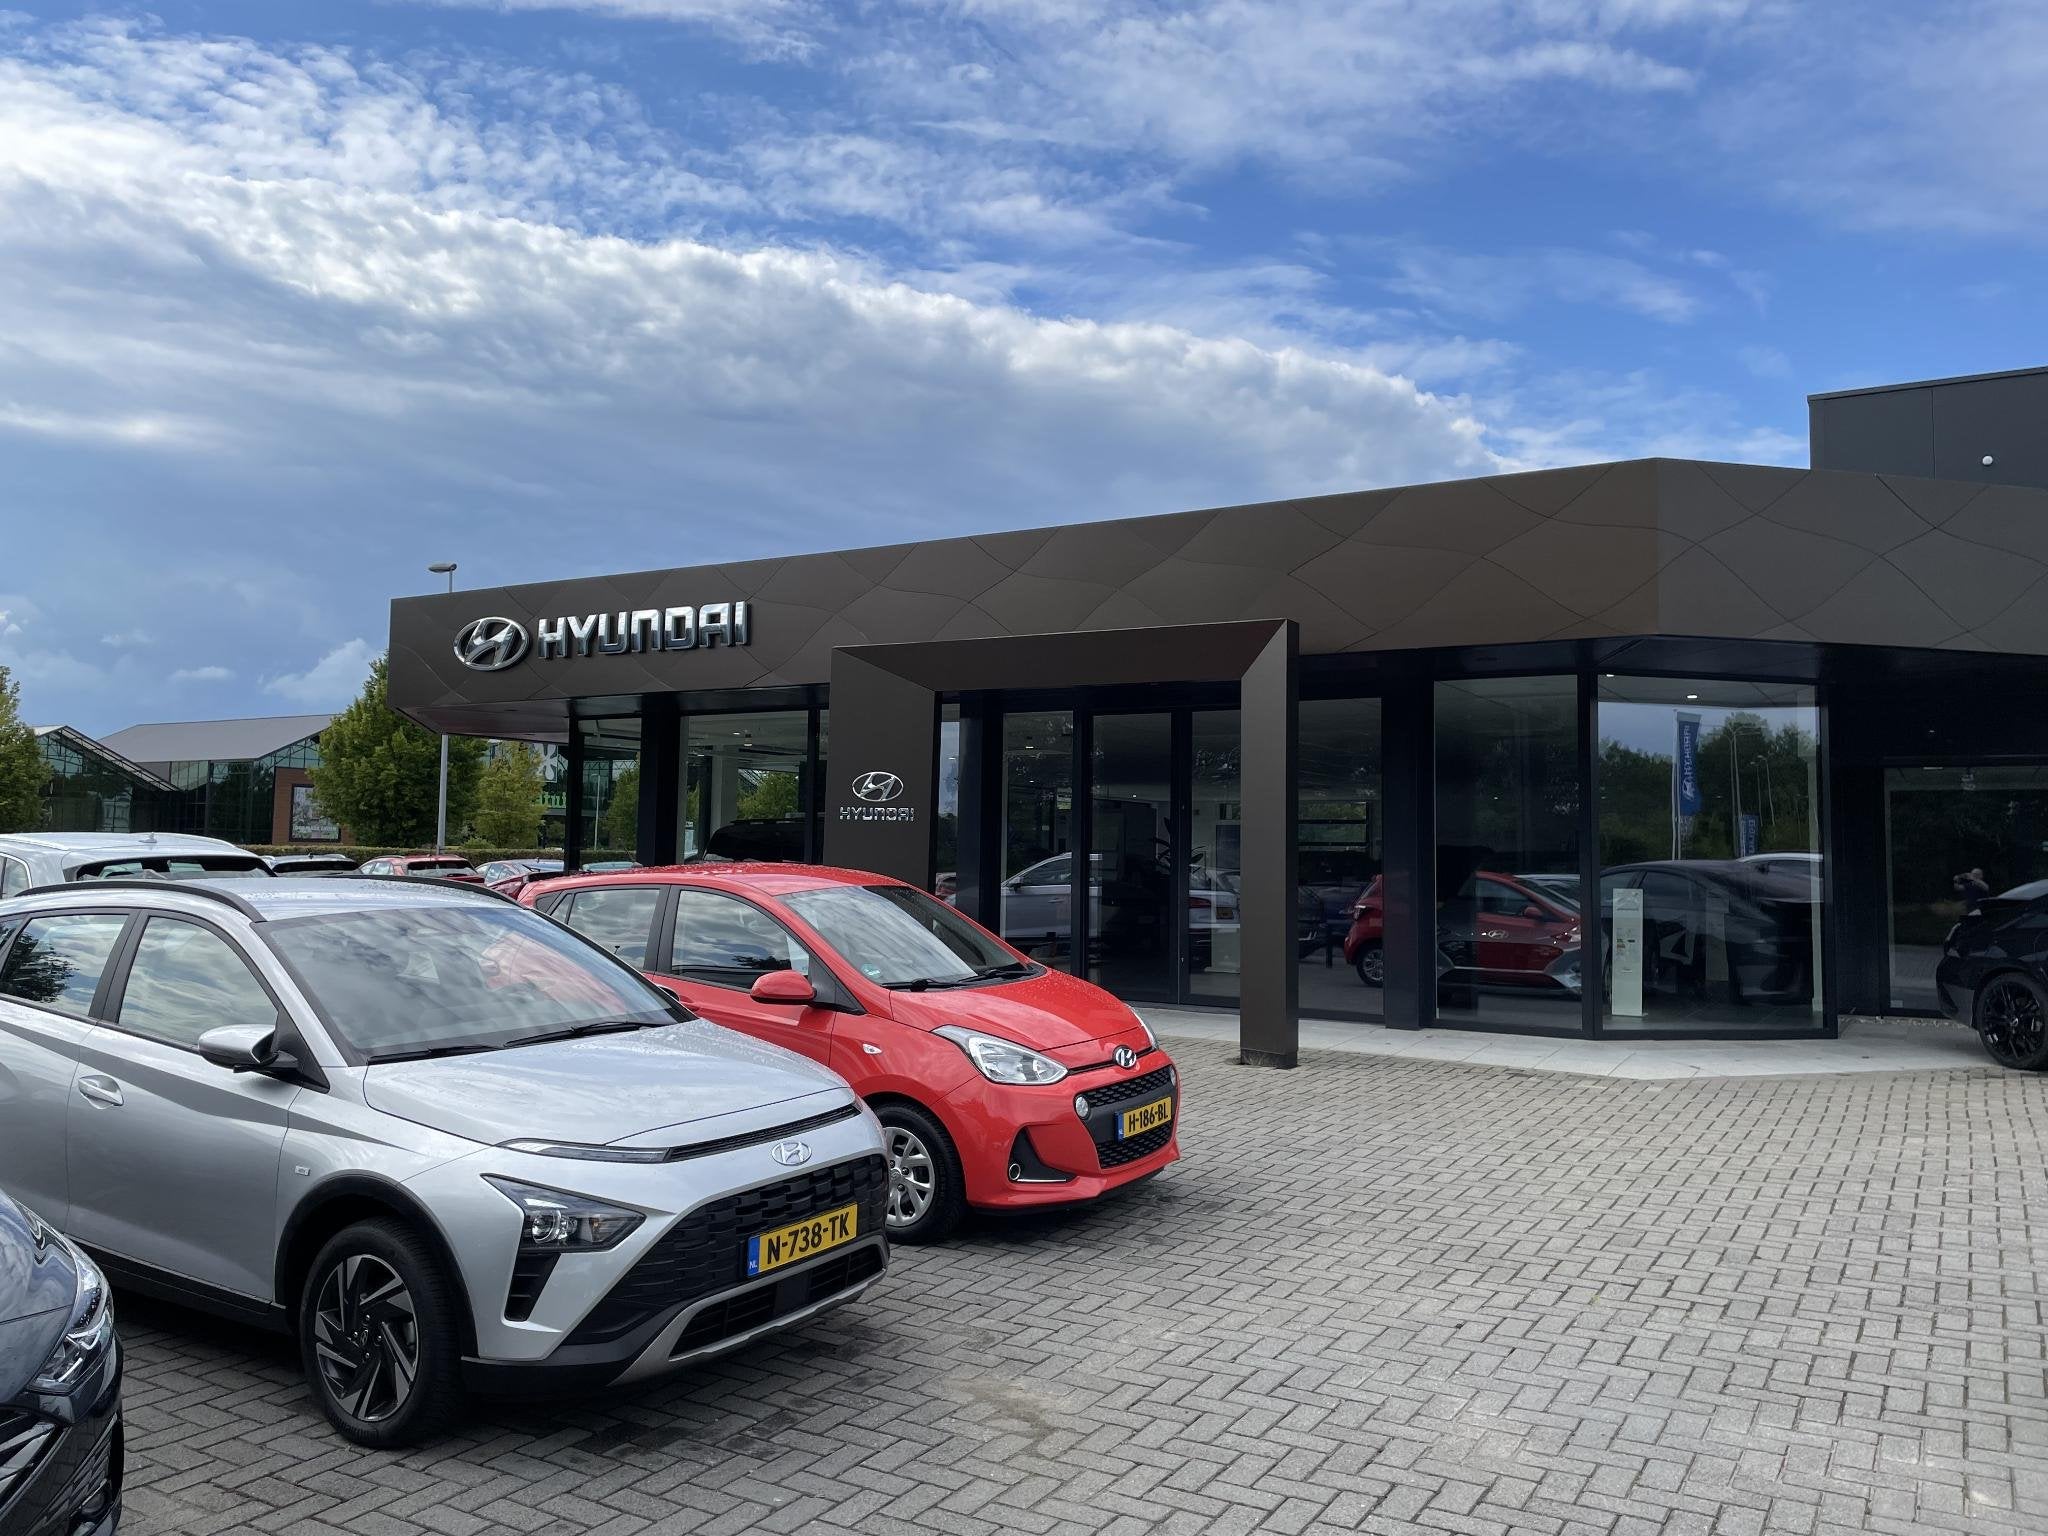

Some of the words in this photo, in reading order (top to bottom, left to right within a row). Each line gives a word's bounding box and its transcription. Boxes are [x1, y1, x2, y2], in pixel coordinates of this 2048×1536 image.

[538, 601, 749, 659] HYUNDAI
[840, 806, 914, 821] HYUNDAI
[1128, 1102, 1168, 1132] H-186-BL
[767, 1211, 849, 1265] N-738-TK
[749, 1260, 758, 1270] NL
